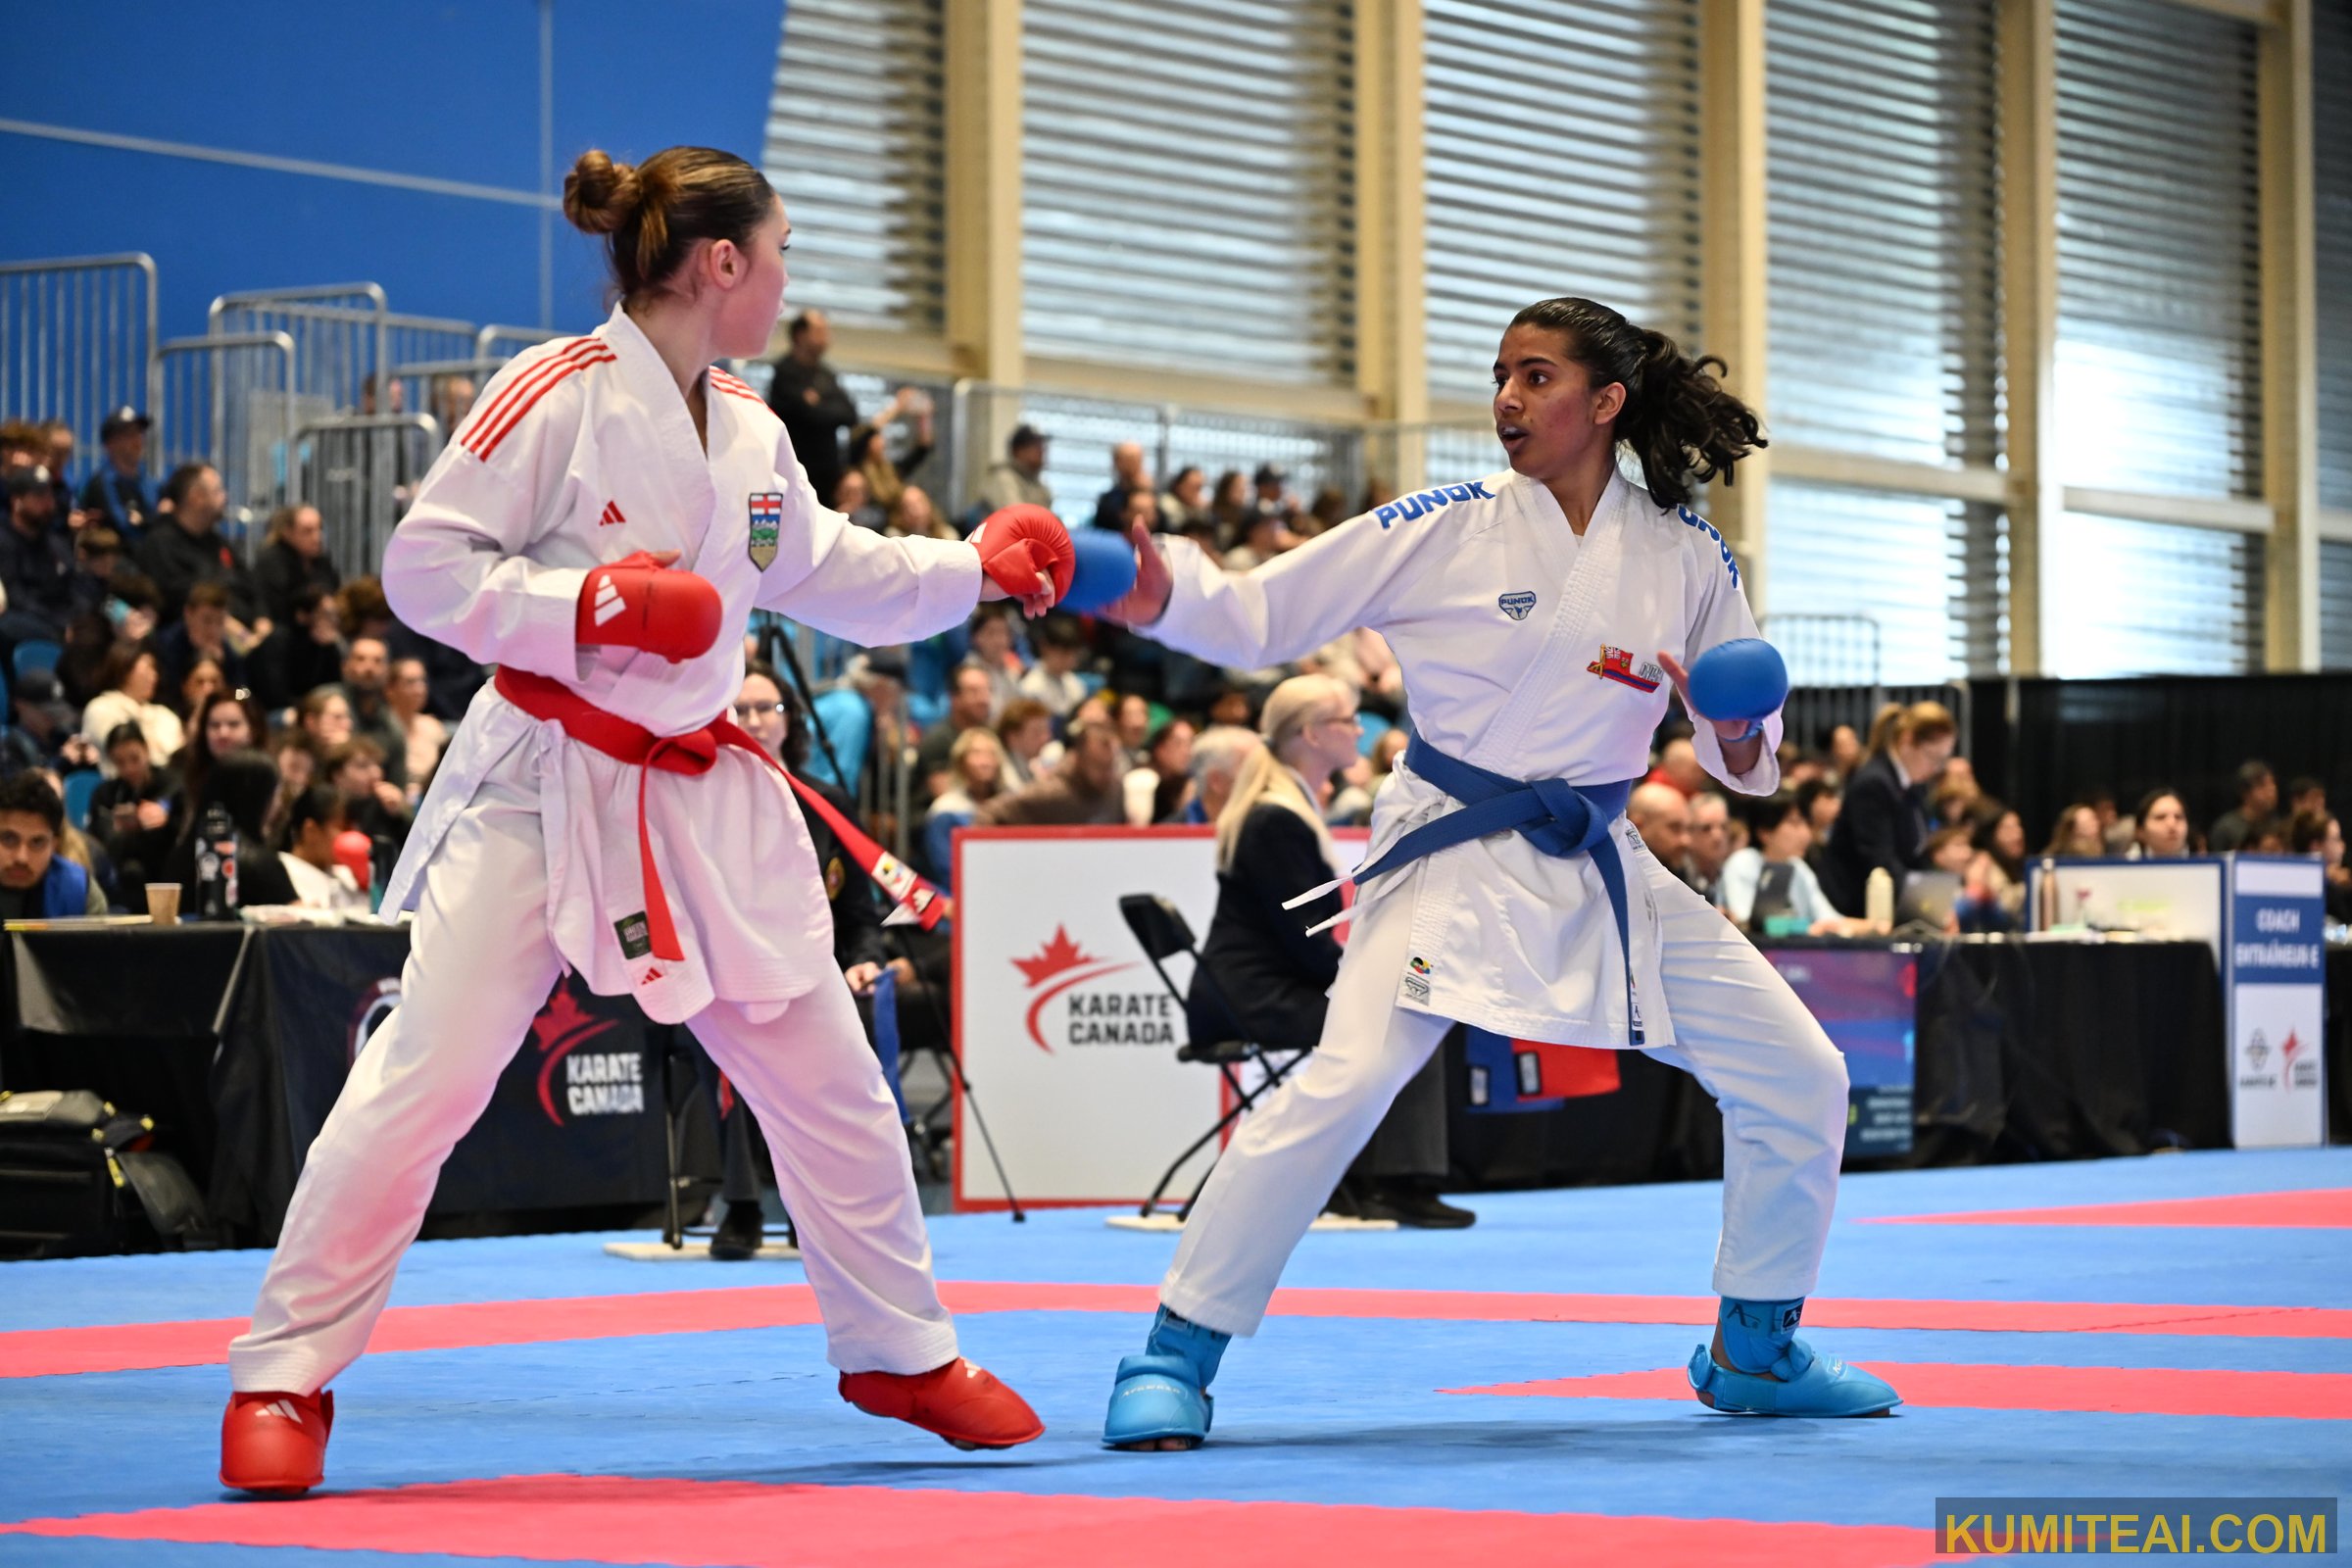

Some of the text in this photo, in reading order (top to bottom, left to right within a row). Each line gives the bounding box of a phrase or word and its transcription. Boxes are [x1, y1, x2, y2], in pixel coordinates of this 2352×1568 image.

[1374, 481, 1496, 530] PUNOK
[1500, 595, 1535, 606] PUNOK
[1068, 993, 1171, 1016] KARATE
[1068, 1021, 1174, 1045] CANADA
[565, 1053, 643, 1084] KARATE
[566, 1085, 645, 1115] CANADA
